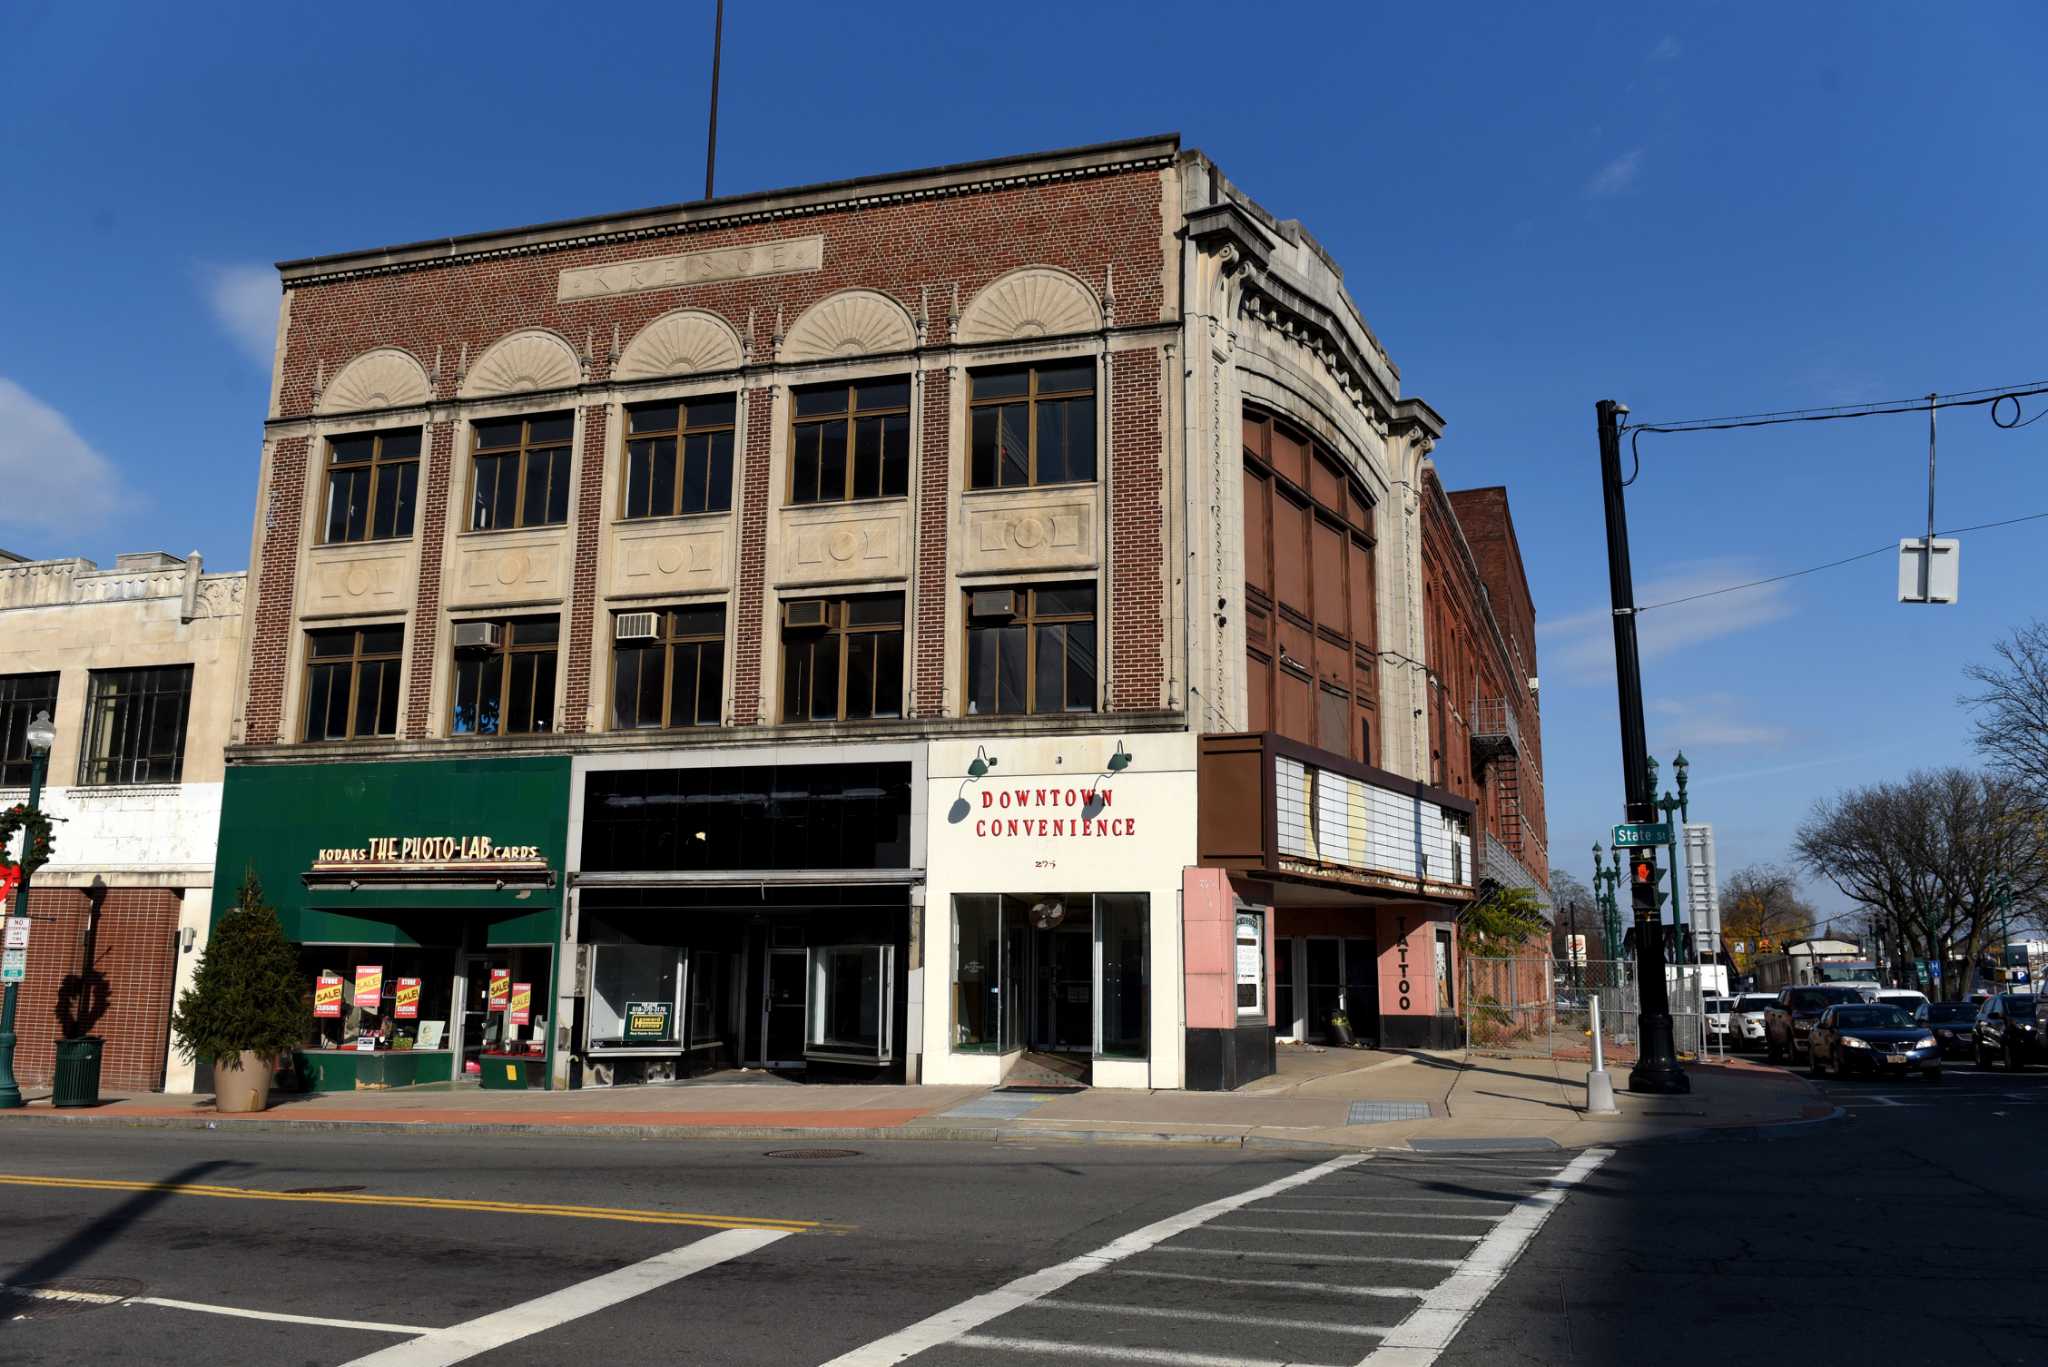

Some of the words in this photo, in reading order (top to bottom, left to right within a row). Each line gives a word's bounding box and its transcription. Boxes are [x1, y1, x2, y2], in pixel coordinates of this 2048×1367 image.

[981, 788, 1113, 809] DOWNTOWN
[976, 818, 1136, 837] CONVENIENCE
[1618, 829, 1652, 842] State
[319, 848, 366, 861] KODAKS
[368, 837, 399, 861] THE
[401, 836, 492, 860] PHOTO-LAB
[493, 846, 538, 859] CARDS
[1396, 916, 1410, 1010] TATTOO
